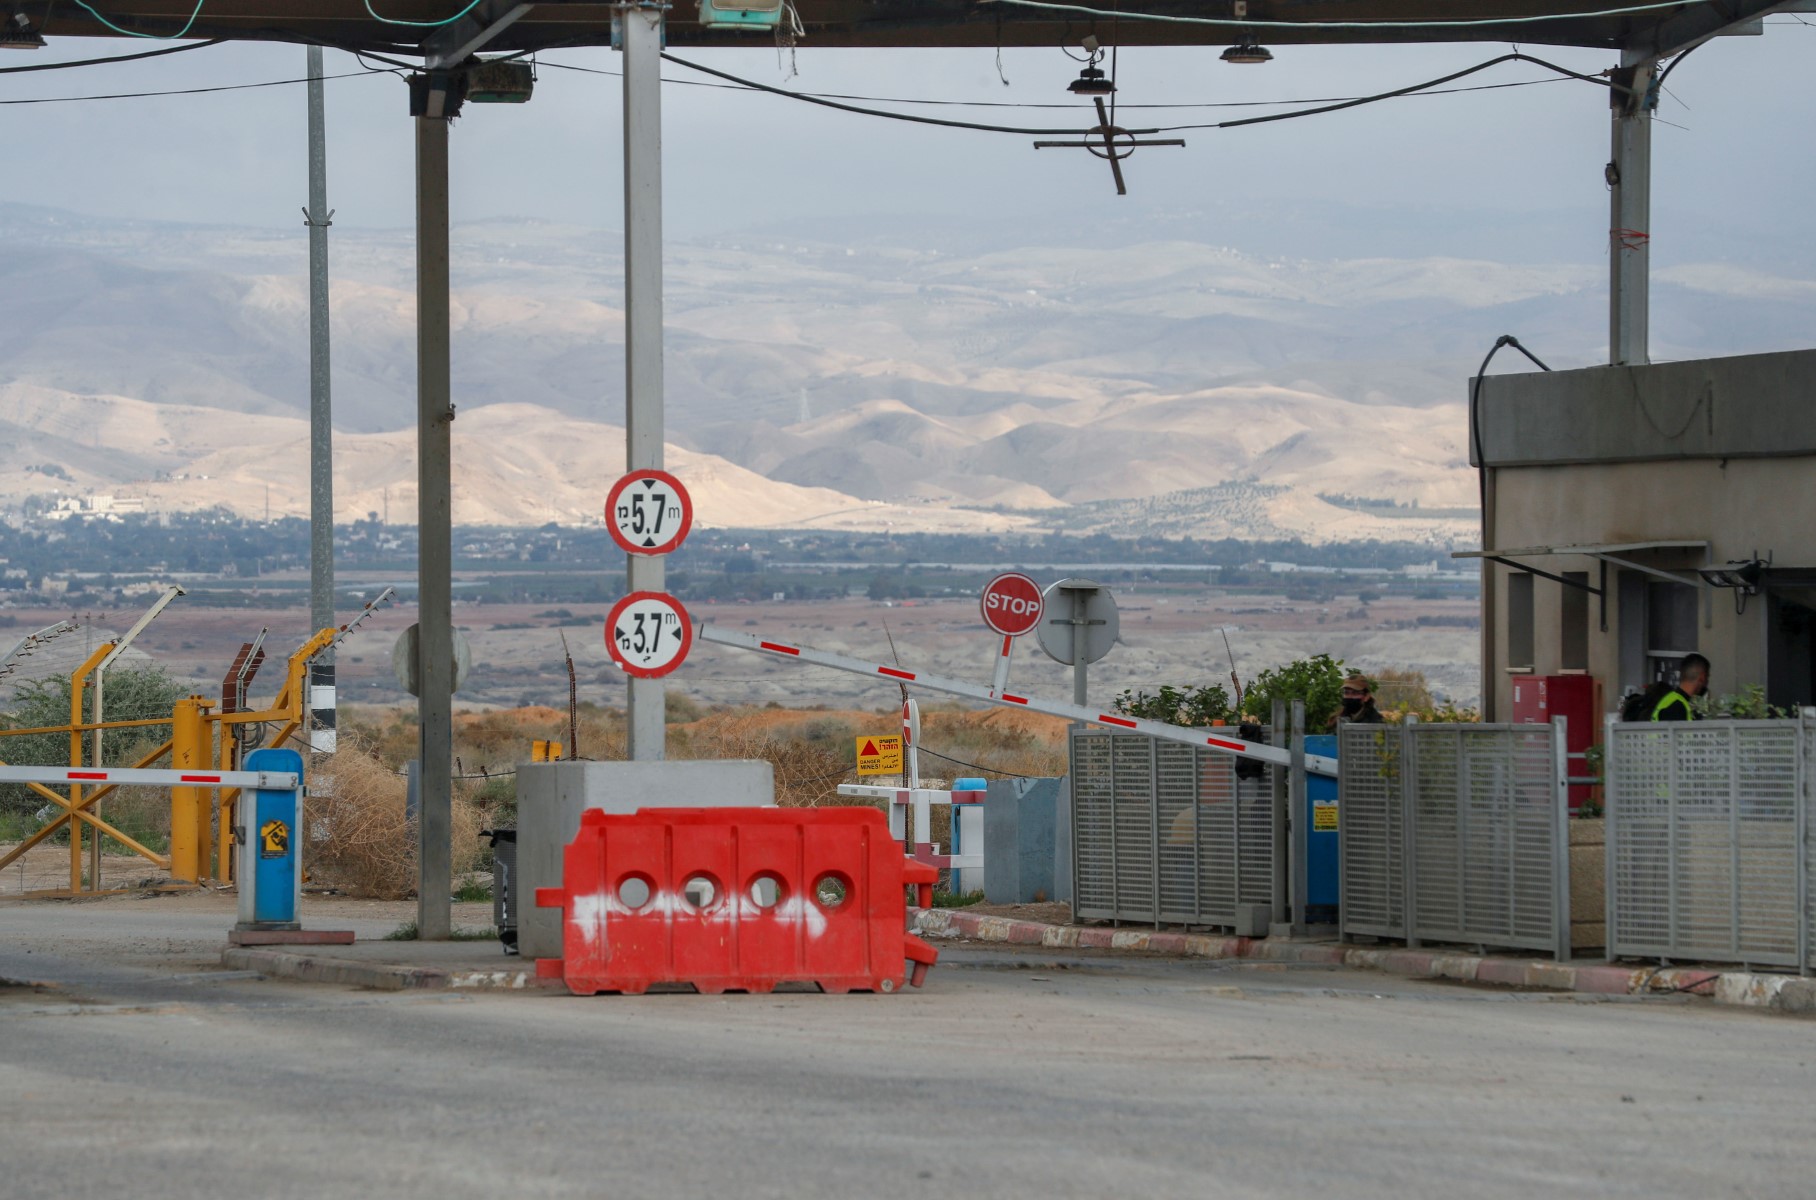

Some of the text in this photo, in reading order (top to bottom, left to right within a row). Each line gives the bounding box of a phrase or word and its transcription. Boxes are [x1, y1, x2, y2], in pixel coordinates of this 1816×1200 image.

[632, 494, 680, 534] 5.7 m
[987, 592, 1039, 616] STOP
[633, 612, 676, 653] 3.7 m
